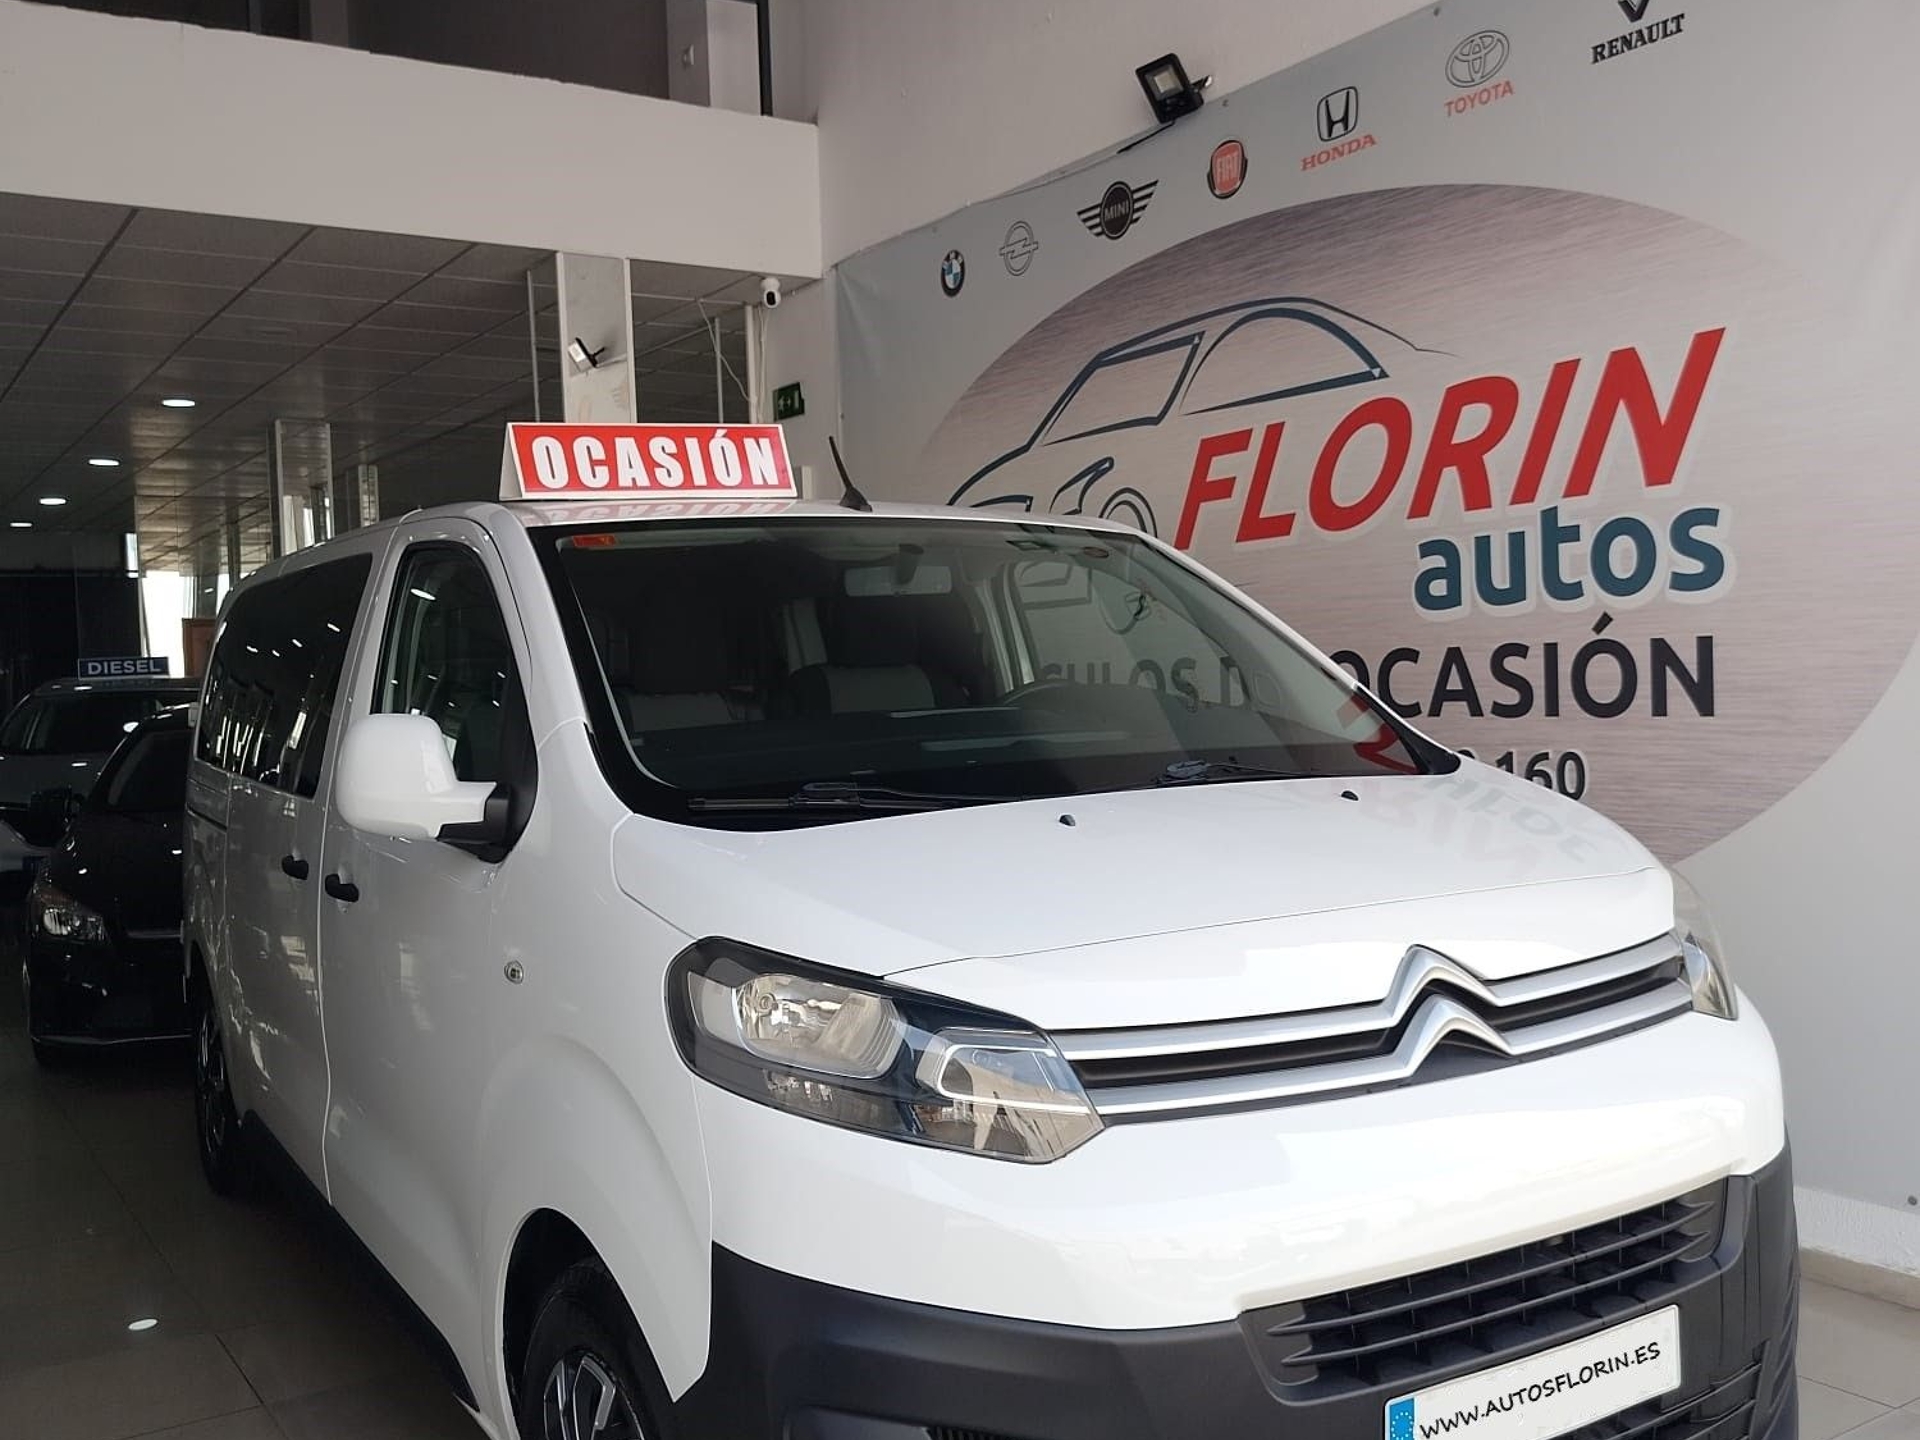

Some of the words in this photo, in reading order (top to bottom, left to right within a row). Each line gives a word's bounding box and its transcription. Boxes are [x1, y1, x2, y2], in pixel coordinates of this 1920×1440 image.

[1592, 13, 1685, 64] RENAULT
[1444, 80, 1515, 117] TOYOTA
[1300, 134, 1377, 171] HONDA
[1105, 200, 1129, 221] MINI
[532, 429, 780, 489] OCASIÓN
[1174, 327, 1726, 551] FLORIN
[1413, 505, 1725, 611] autos
[87, 660, 162, 675] DIESEL
[1419, 1341, 1661, 1440] WWW.AUTOSFLORIN.ES
